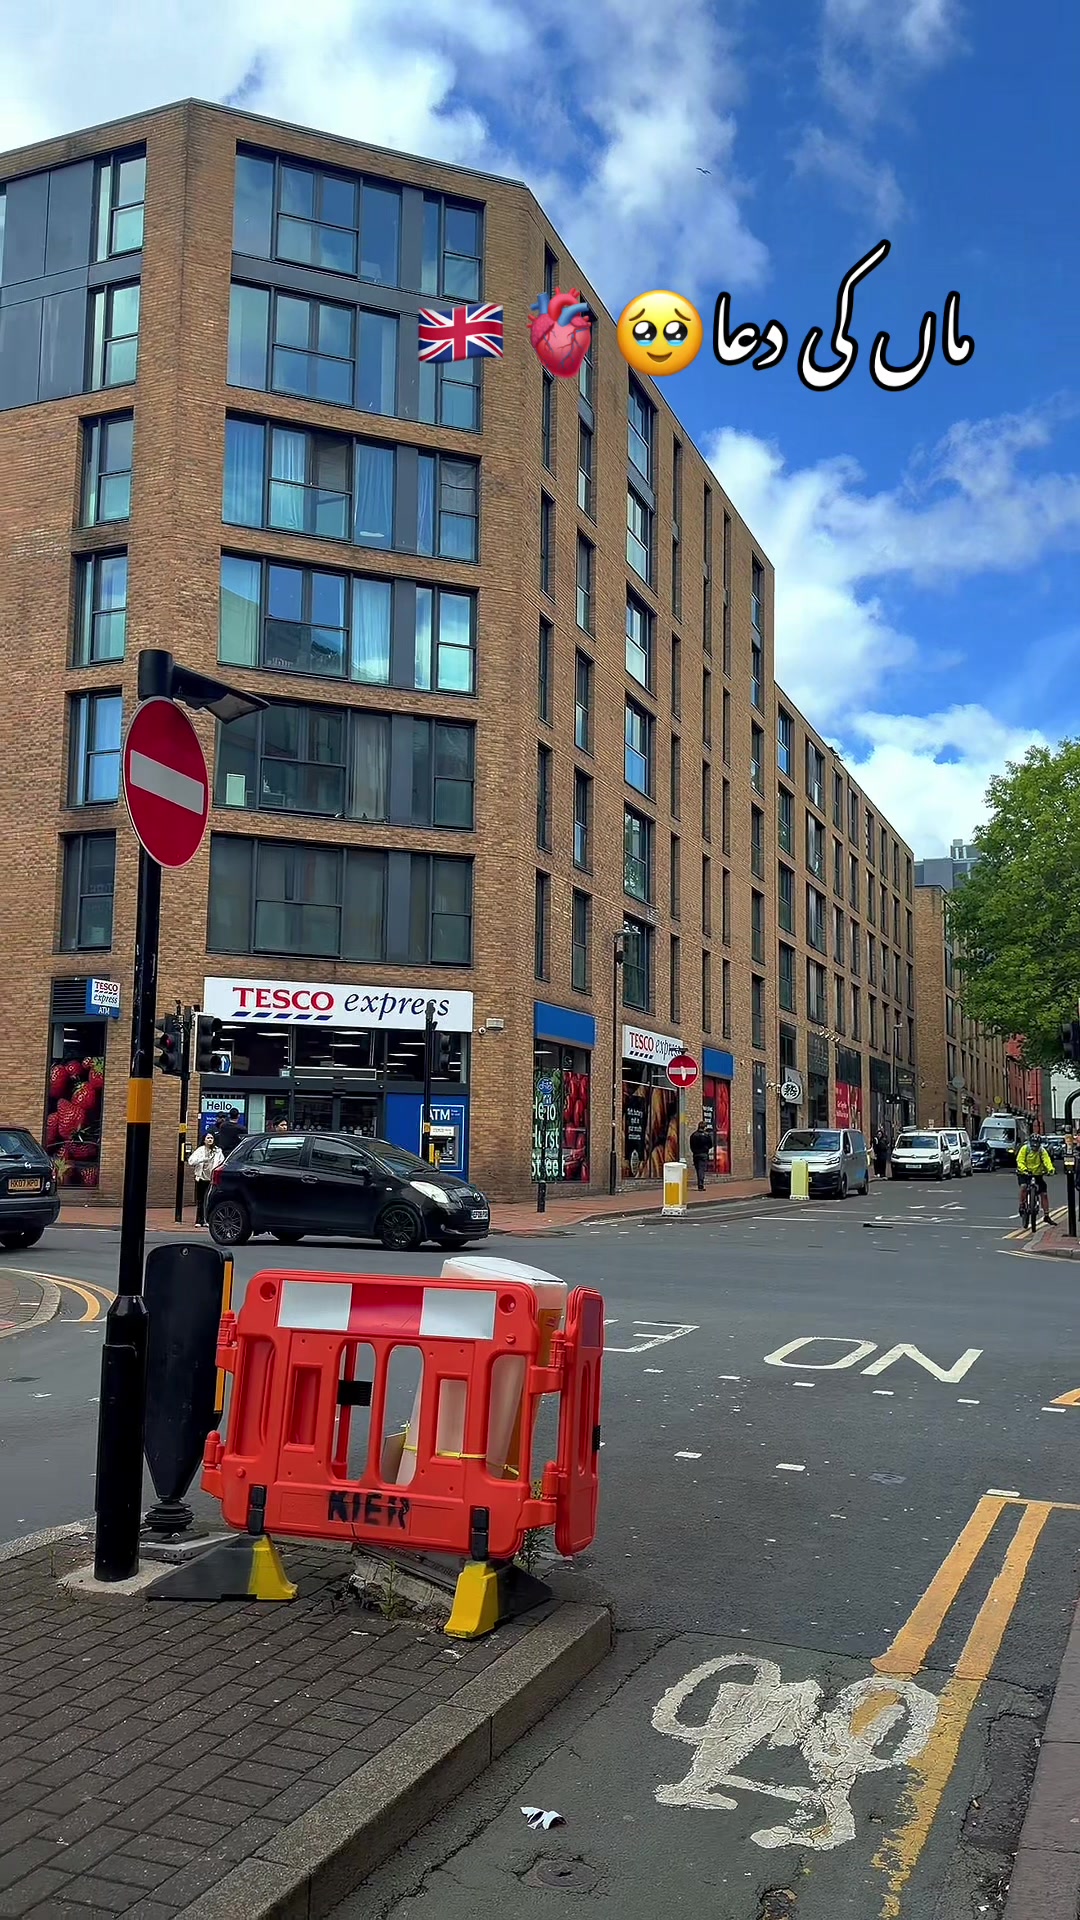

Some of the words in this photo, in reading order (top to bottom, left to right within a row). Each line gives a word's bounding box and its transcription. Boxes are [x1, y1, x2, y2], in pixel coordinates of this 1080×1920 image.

[95, 981, 118, 992] TESCO
[93, 994, 118, 1004] express
[232, 986, 334, 1011] TESCO
[98, 1006, 110, 1015] ATM
[629, 1032, 654, 1051] TESCO
[206, 1101, 233, 1110] Hello
[531, 1153, 565, 1177] Steet
[328, 1490, 410, 1529] KIER
